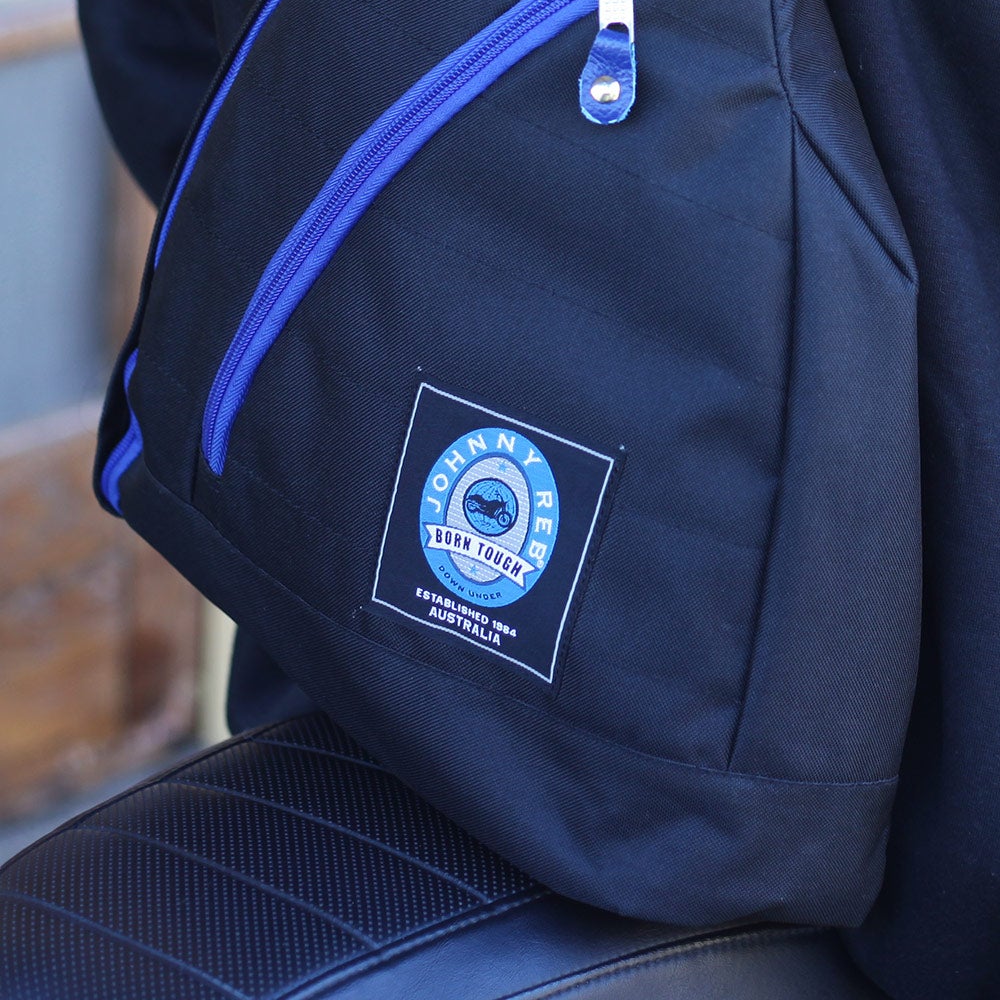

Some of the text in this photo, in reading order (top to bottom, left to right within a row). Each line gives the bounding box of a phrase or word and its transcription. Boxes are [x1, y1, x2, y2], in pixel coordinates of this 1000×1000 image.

[427, 432, 543, 514] JOHNNY
[435, 528, 523, 577] BORN TOUGH
[438, 565, 502, 600] DOWN UNDER
[415, 587, 489, 625] ESTABLISHED
[428, 606, 501, 646] AUSTRALIA
